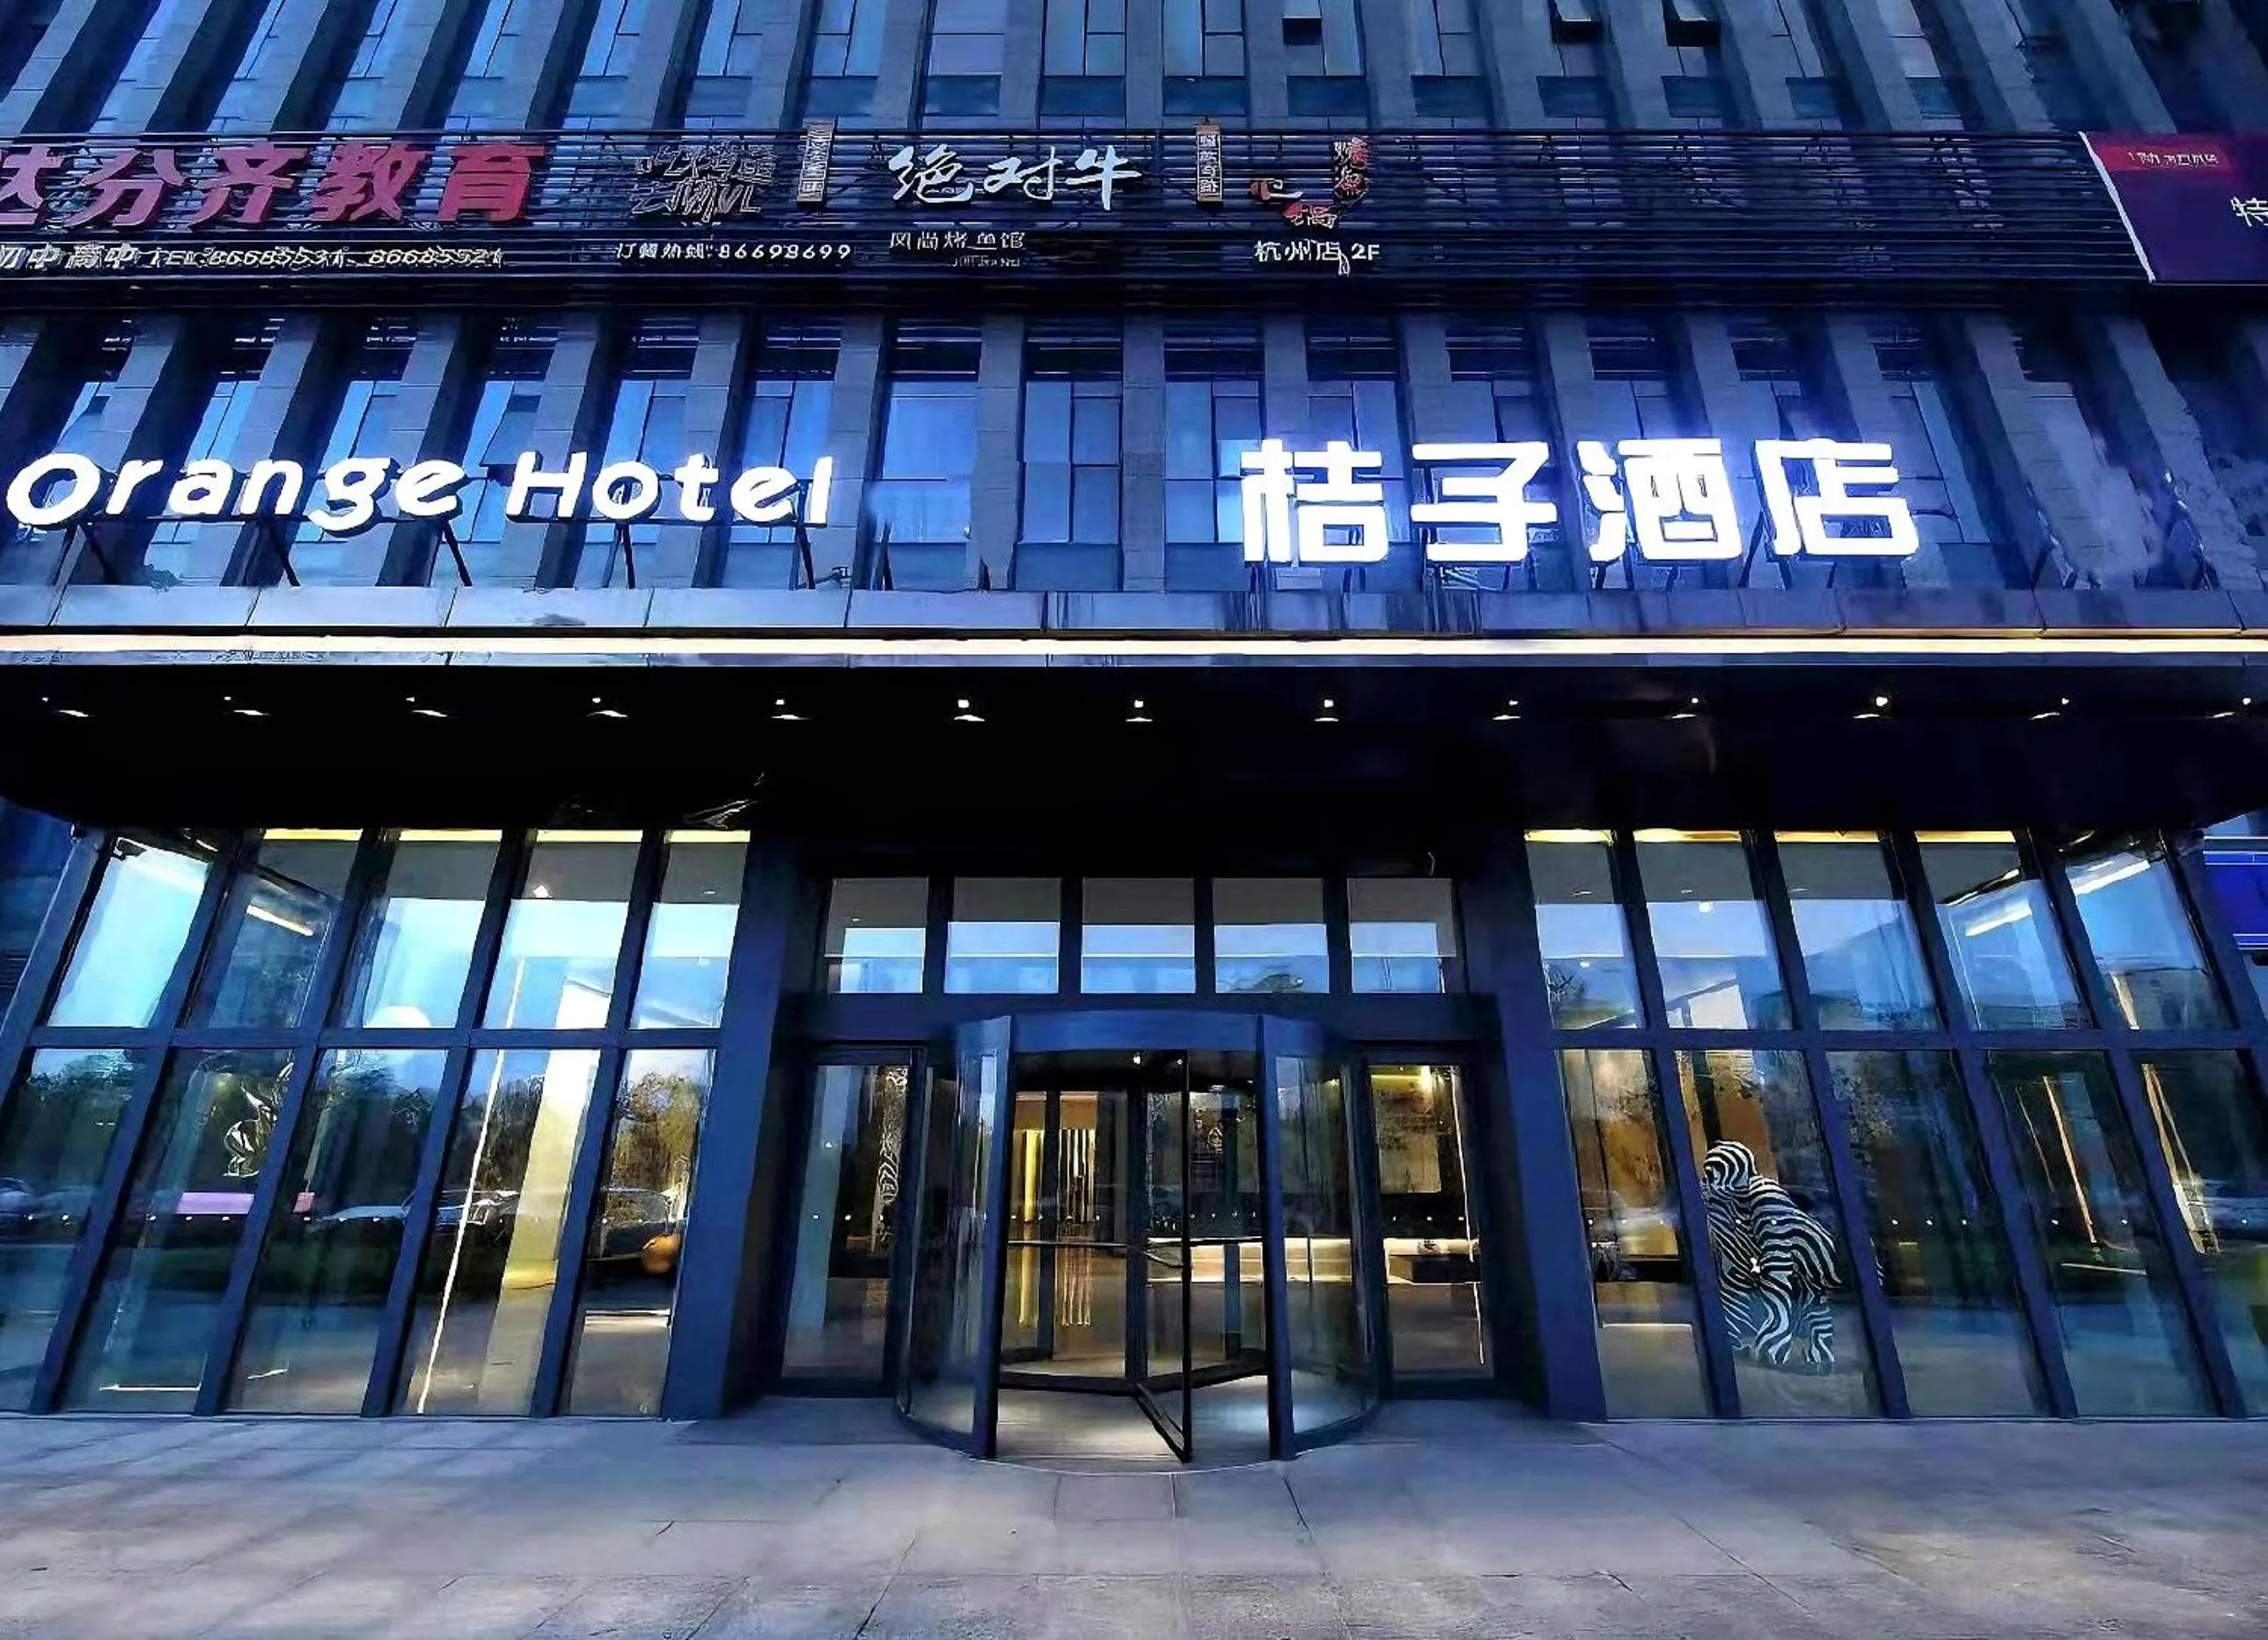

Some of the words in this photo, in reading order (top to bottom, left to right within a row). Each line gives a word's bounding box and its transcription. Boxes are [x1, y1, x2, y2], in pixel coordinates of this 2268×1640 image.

[888, 143, 1142, 210] 绝对牛
[5, 451, 466, 532] Orange
[505, 450, 833, 524] Hotel
[1240, 438, 1919, 563] 桔子酒店
